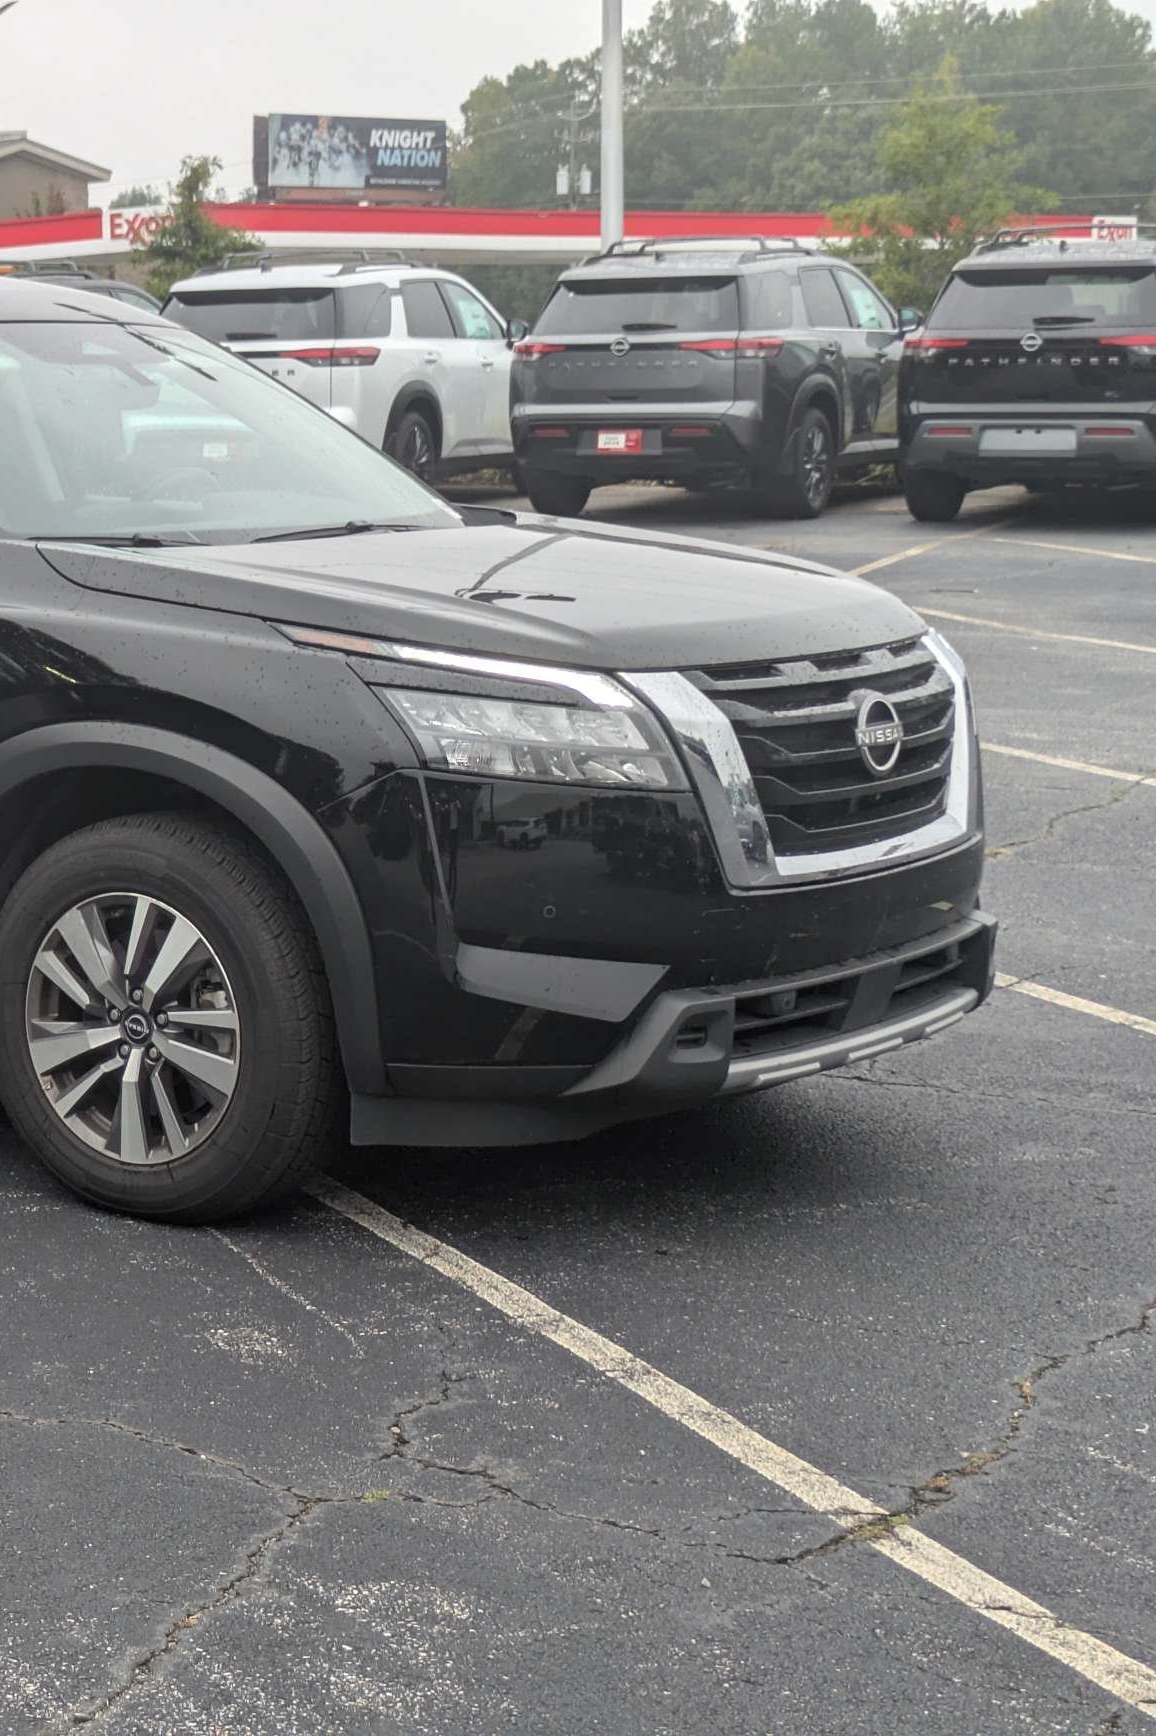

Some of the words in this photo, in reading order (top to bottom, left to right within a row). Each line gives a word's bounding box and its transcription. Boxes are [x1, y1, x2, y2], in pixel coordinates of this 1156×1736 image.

[369, 128, 436, 149] KNIGHT
[376, 148, 442, 167] NATION
[947, 356, 1120, 367] PATHFINDER
[858, 726, 903, 746] NISSA
